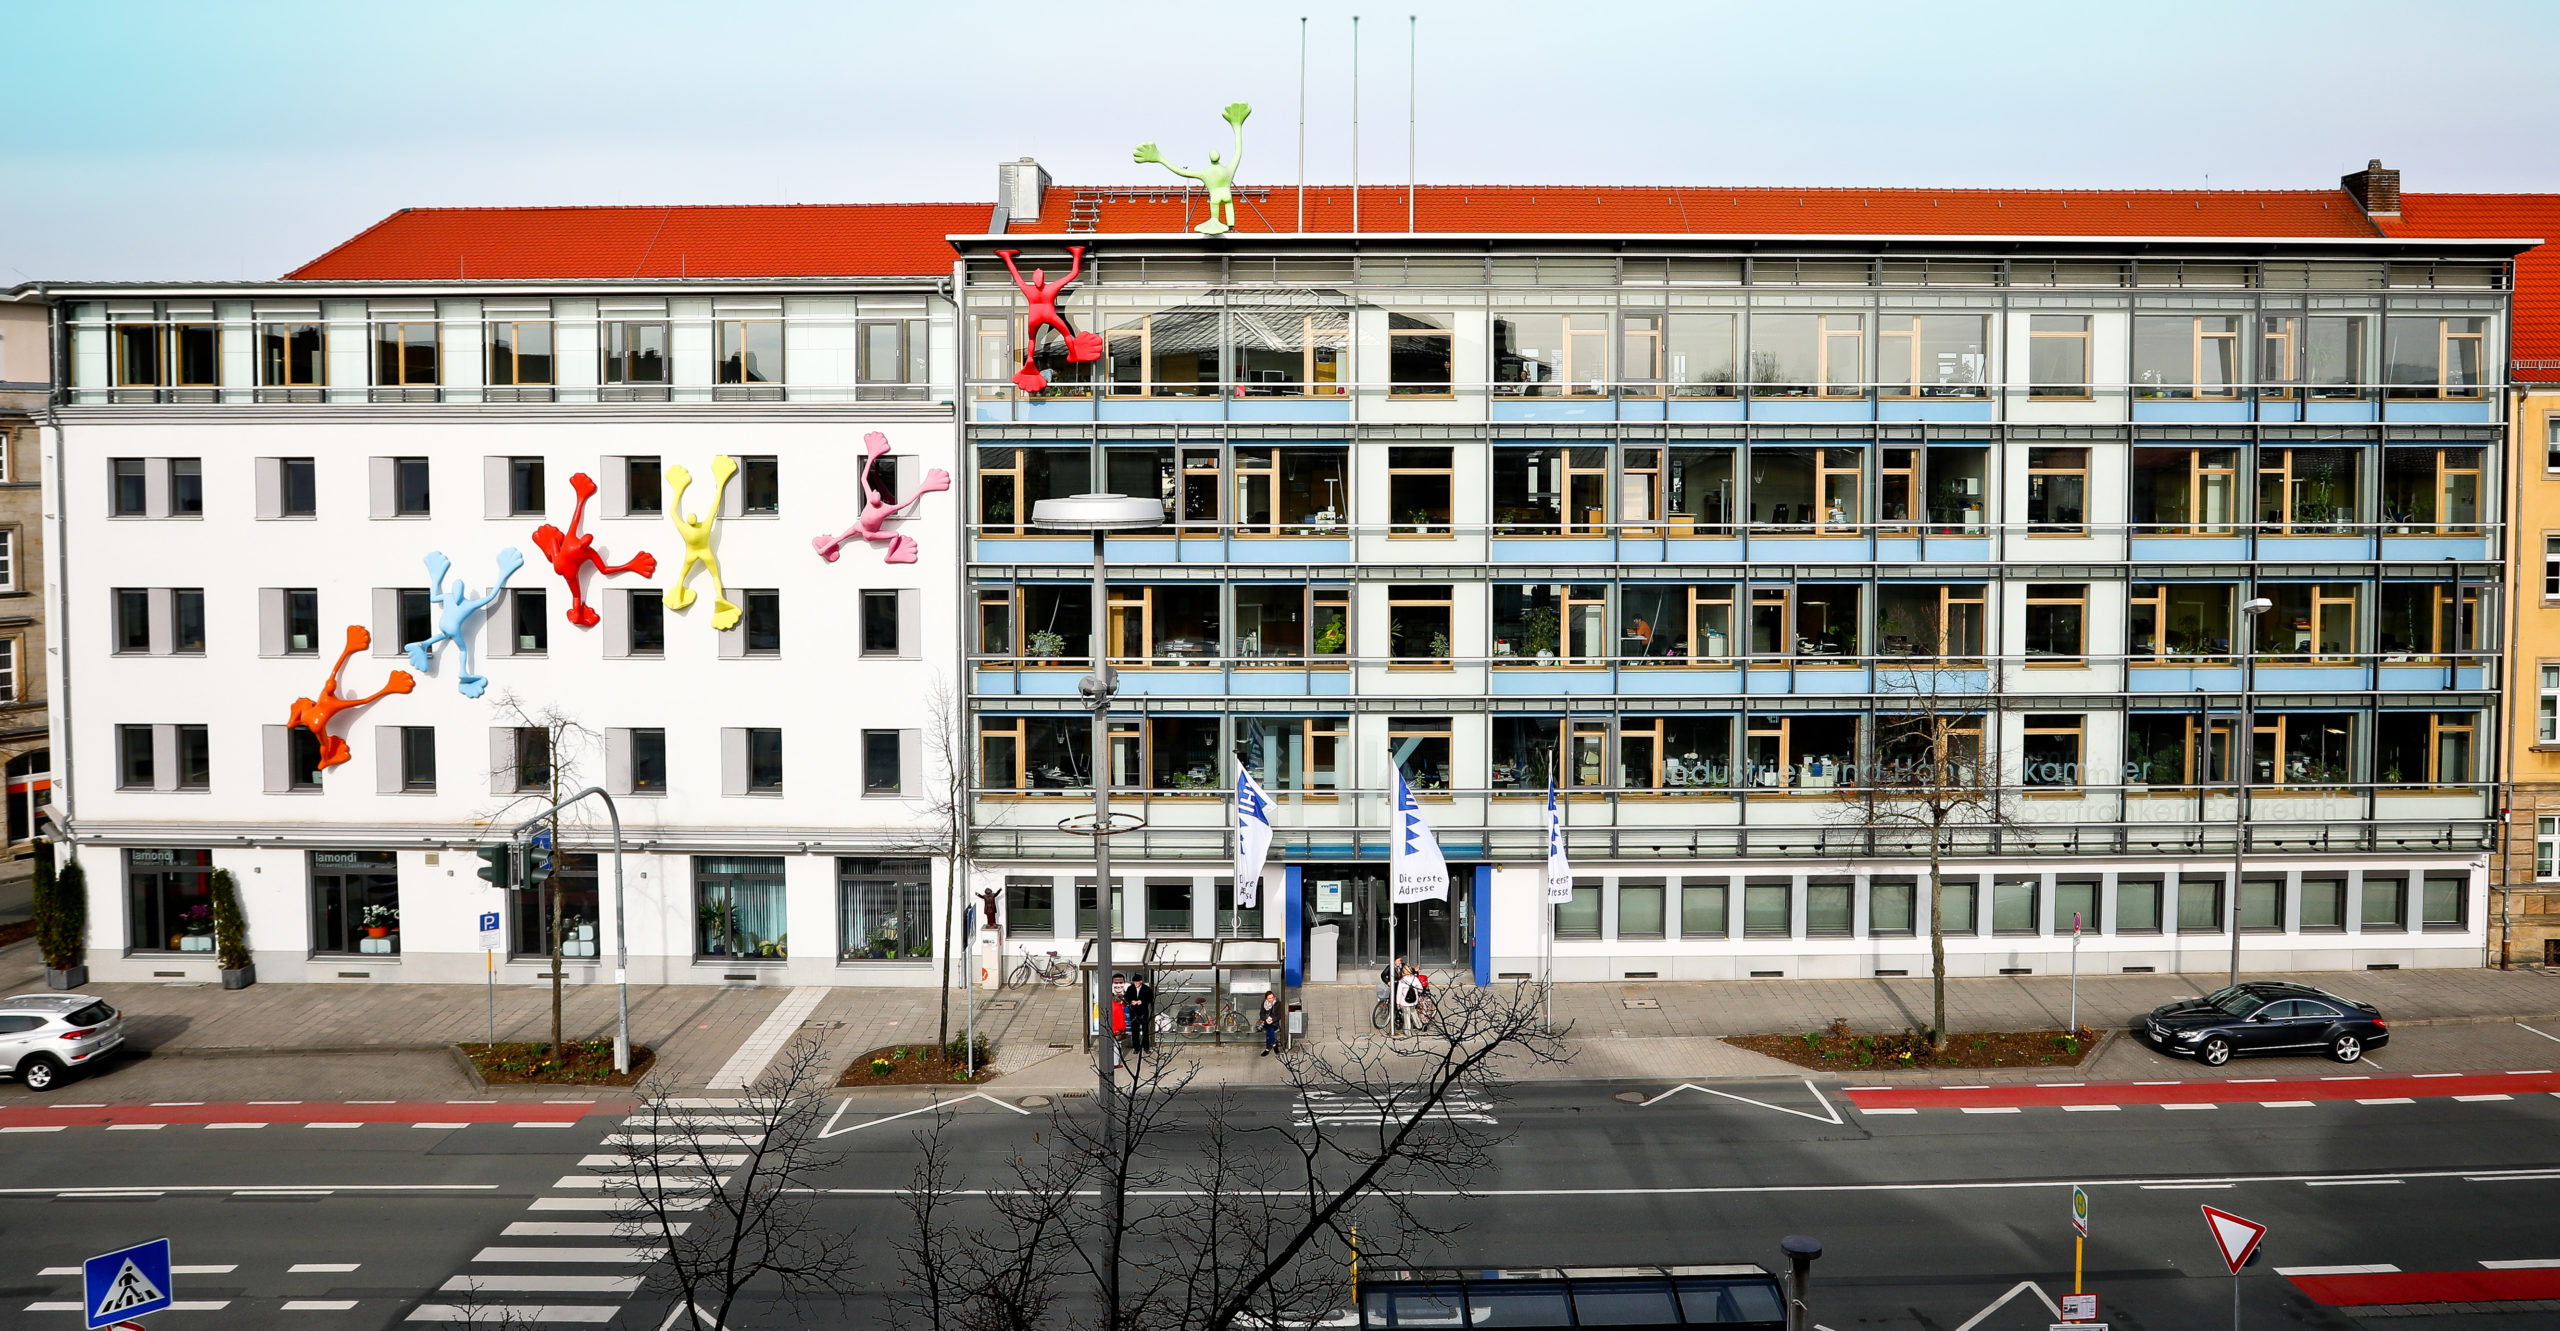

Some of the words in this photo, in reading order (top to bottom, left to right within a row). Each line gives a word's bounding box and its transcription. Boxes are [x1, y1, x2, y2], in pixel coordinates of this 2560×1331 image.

[132, 849, 174, 860] lamondi
[315, 852, 357, 863] lamondi
[1399, 873, 1412, 884] Die
[1416, 875, 1443, 883] erste
[1398, 884, 1435, 895] Adresse
[484, 916, 495, 931] P
